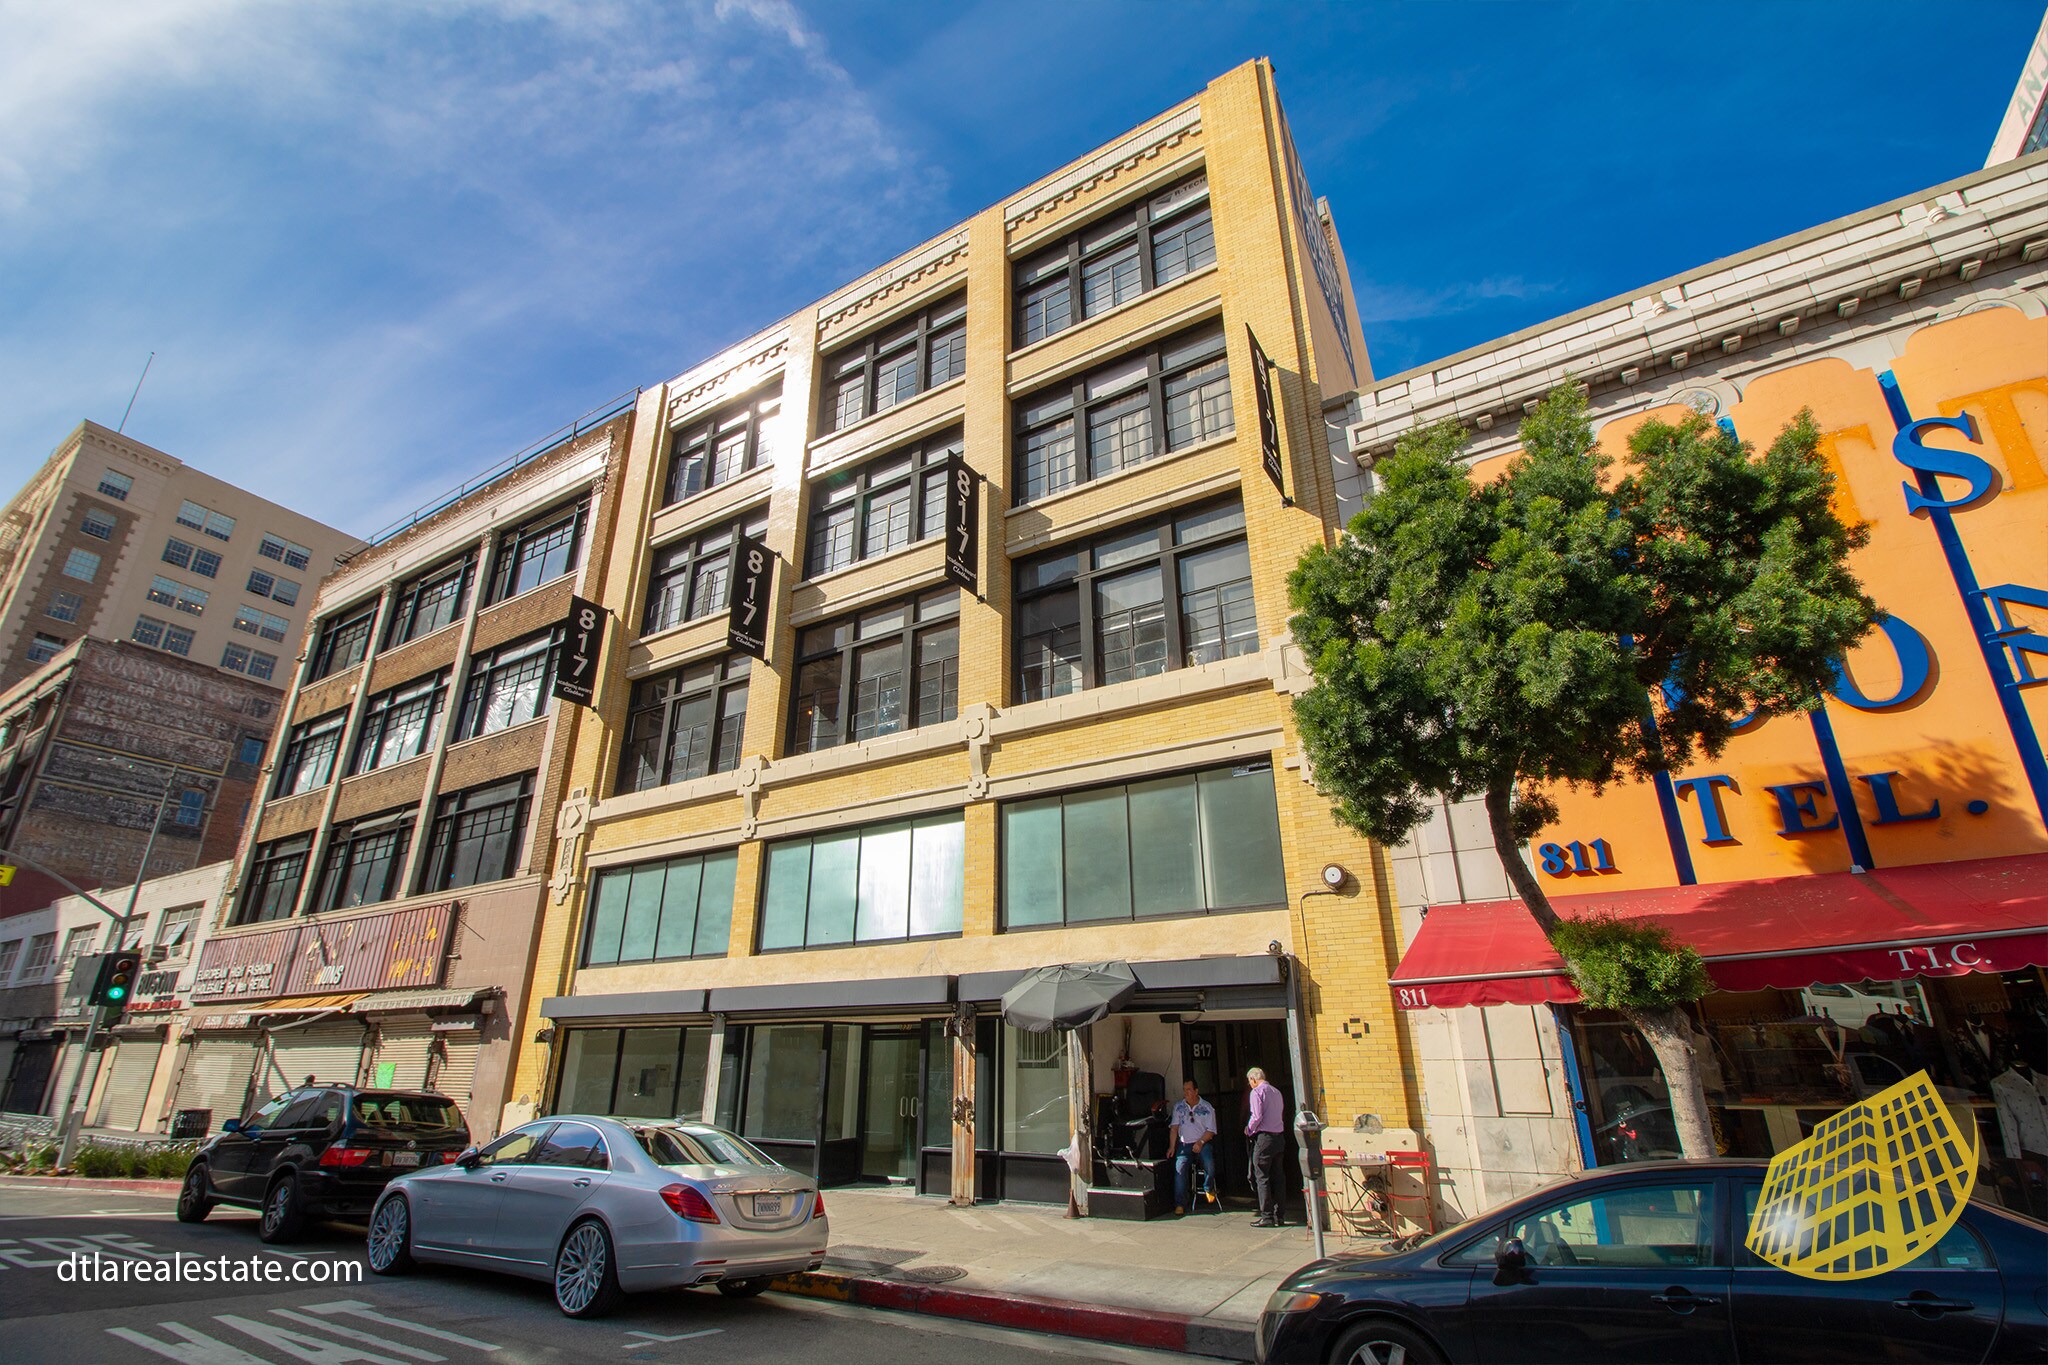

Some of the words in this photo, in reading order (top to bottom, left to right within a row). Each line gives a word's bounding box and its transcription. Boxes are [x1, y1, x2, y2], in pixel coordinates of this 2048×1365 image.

[956, 469, 971, 555] 817
[742, 549, 764, 627] 817
[573, 607, 597, 677] 817
[1538, 837, 1616, 875] 811
[1889, 942, 1992, 972] T.I.C.
[1400, 988, 1429, 1007] 811
[1193, 1043, 1212, 1058] 817
